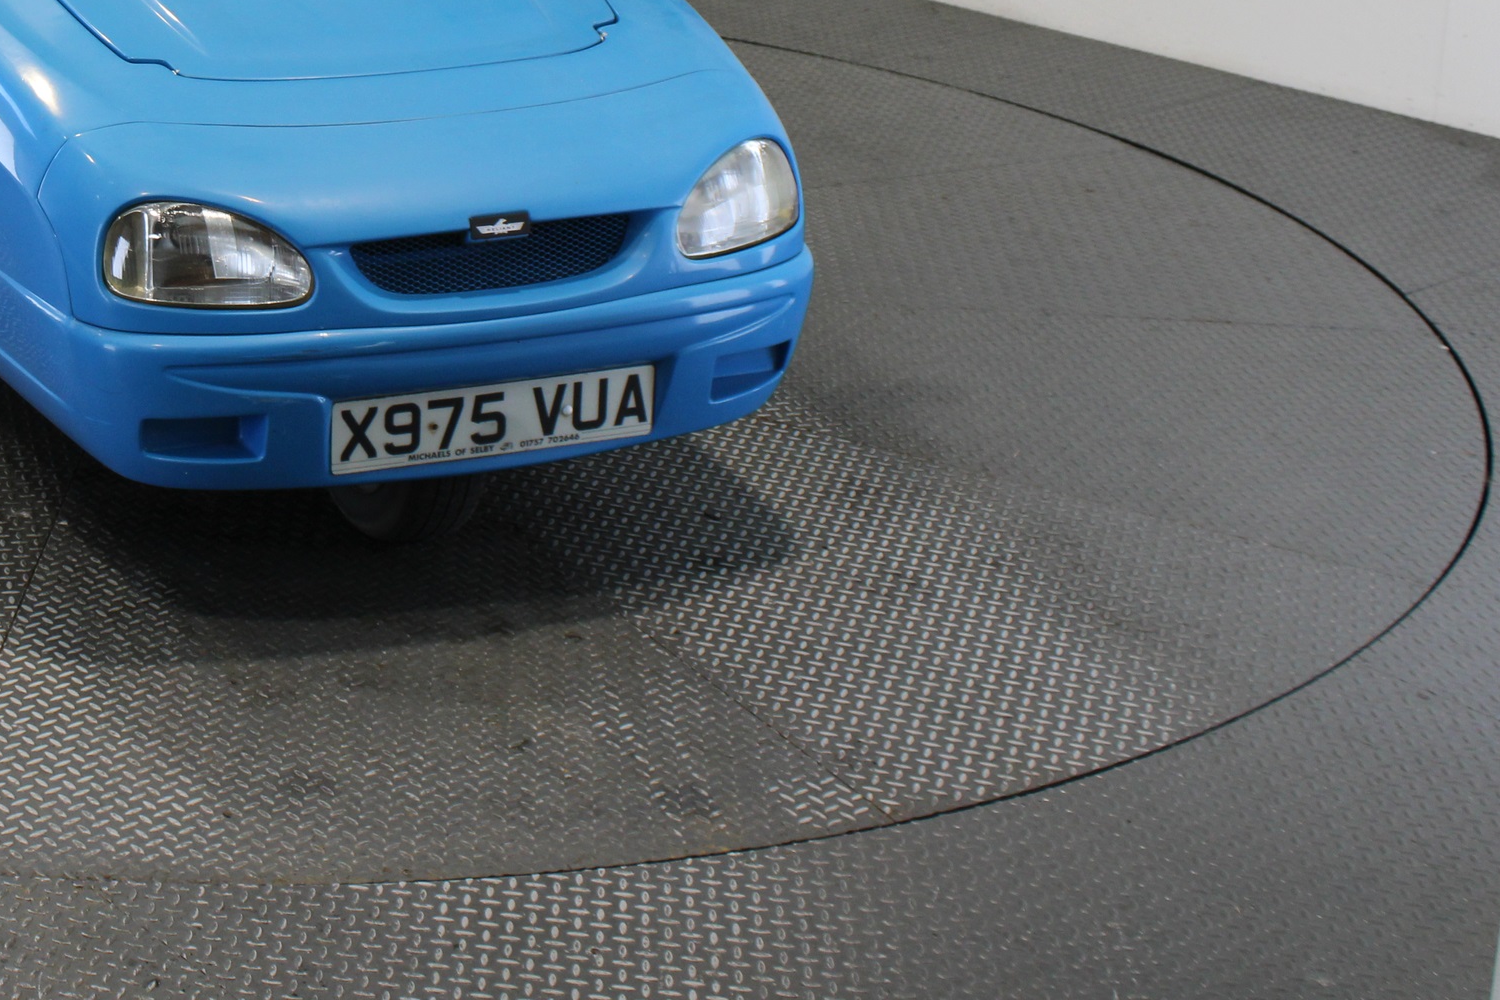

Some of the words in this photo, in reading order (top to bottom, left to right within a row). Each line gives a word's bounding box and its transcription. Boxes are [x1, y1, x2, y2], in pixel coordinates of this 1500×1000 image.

[340, 391, 507, 462] X975
[533, 374, 648, 436] VUA
[408, 451, 451, 461] MICHAELS
[455, 448, 466, 456] OF
[470, 445, 495, 454] SELBY
